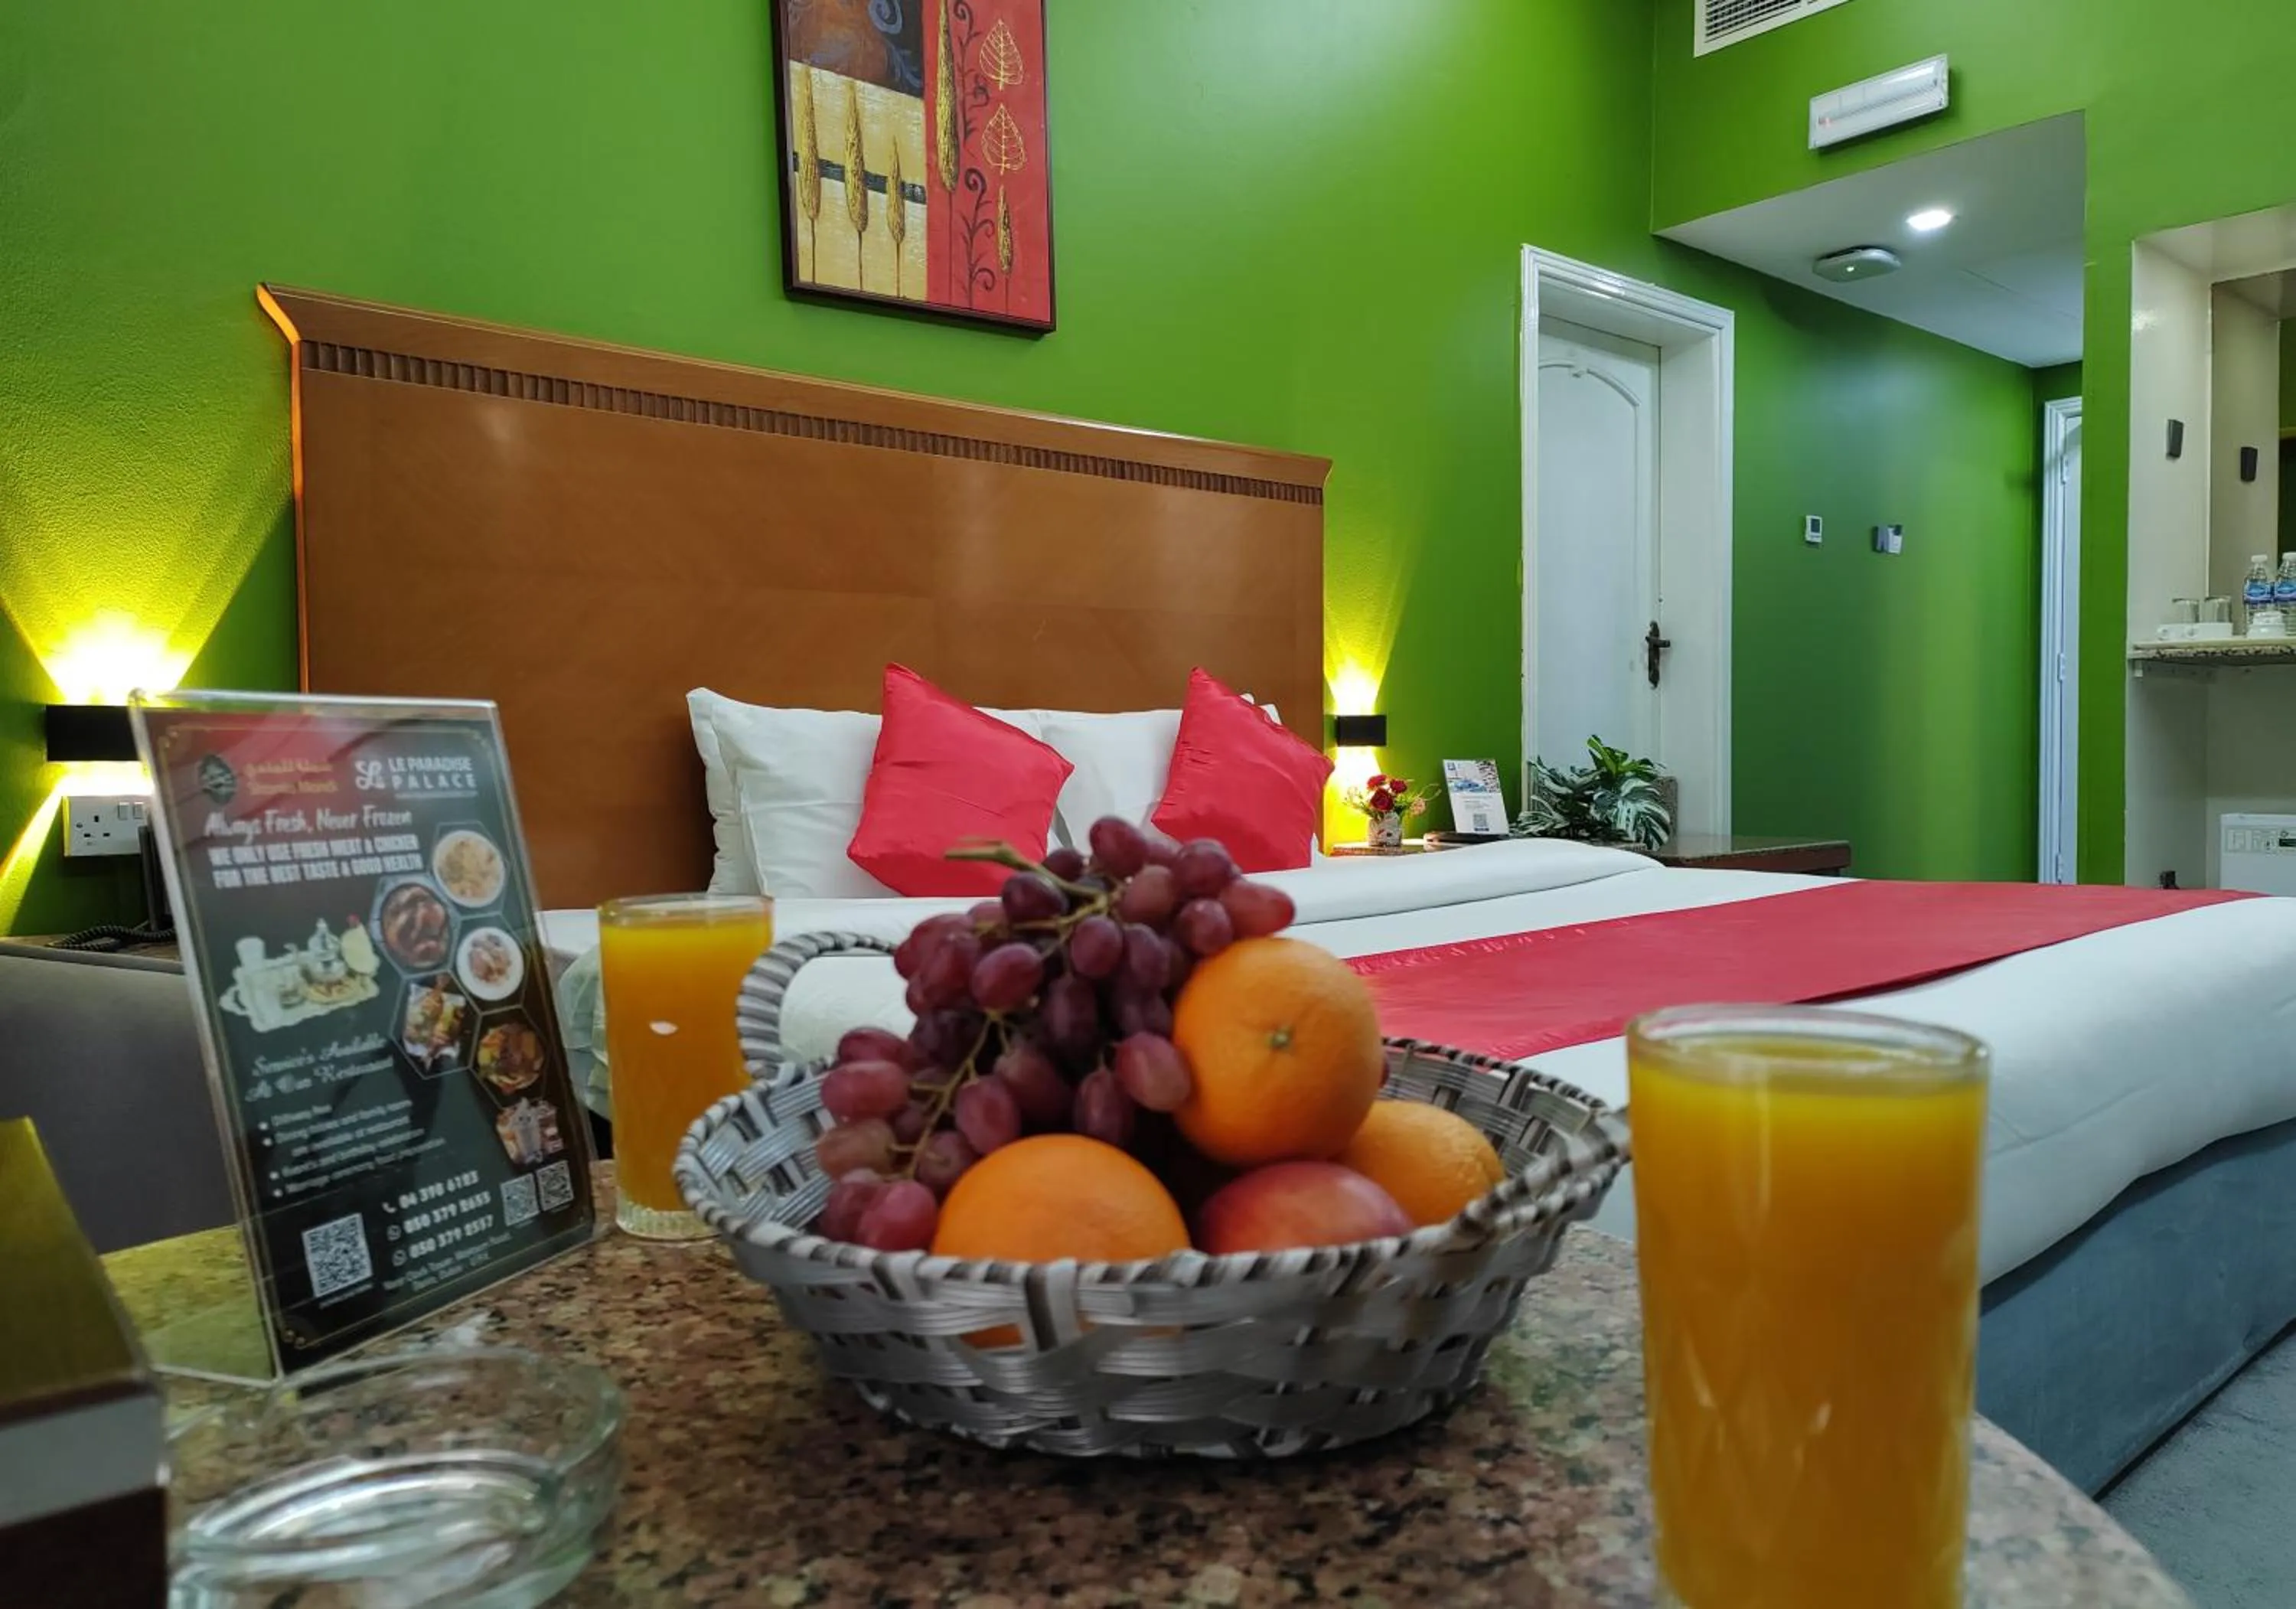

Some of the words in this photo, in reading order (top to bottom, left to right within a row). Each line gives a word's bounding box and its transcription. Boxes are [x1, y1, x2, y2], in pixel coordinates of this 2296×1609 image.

[391, 773, 478, 790] PALACE
[204, 811, 262, 845] Always
[316, 808, 358, 831] Never
[363, 804, 413, 827] Frozen
